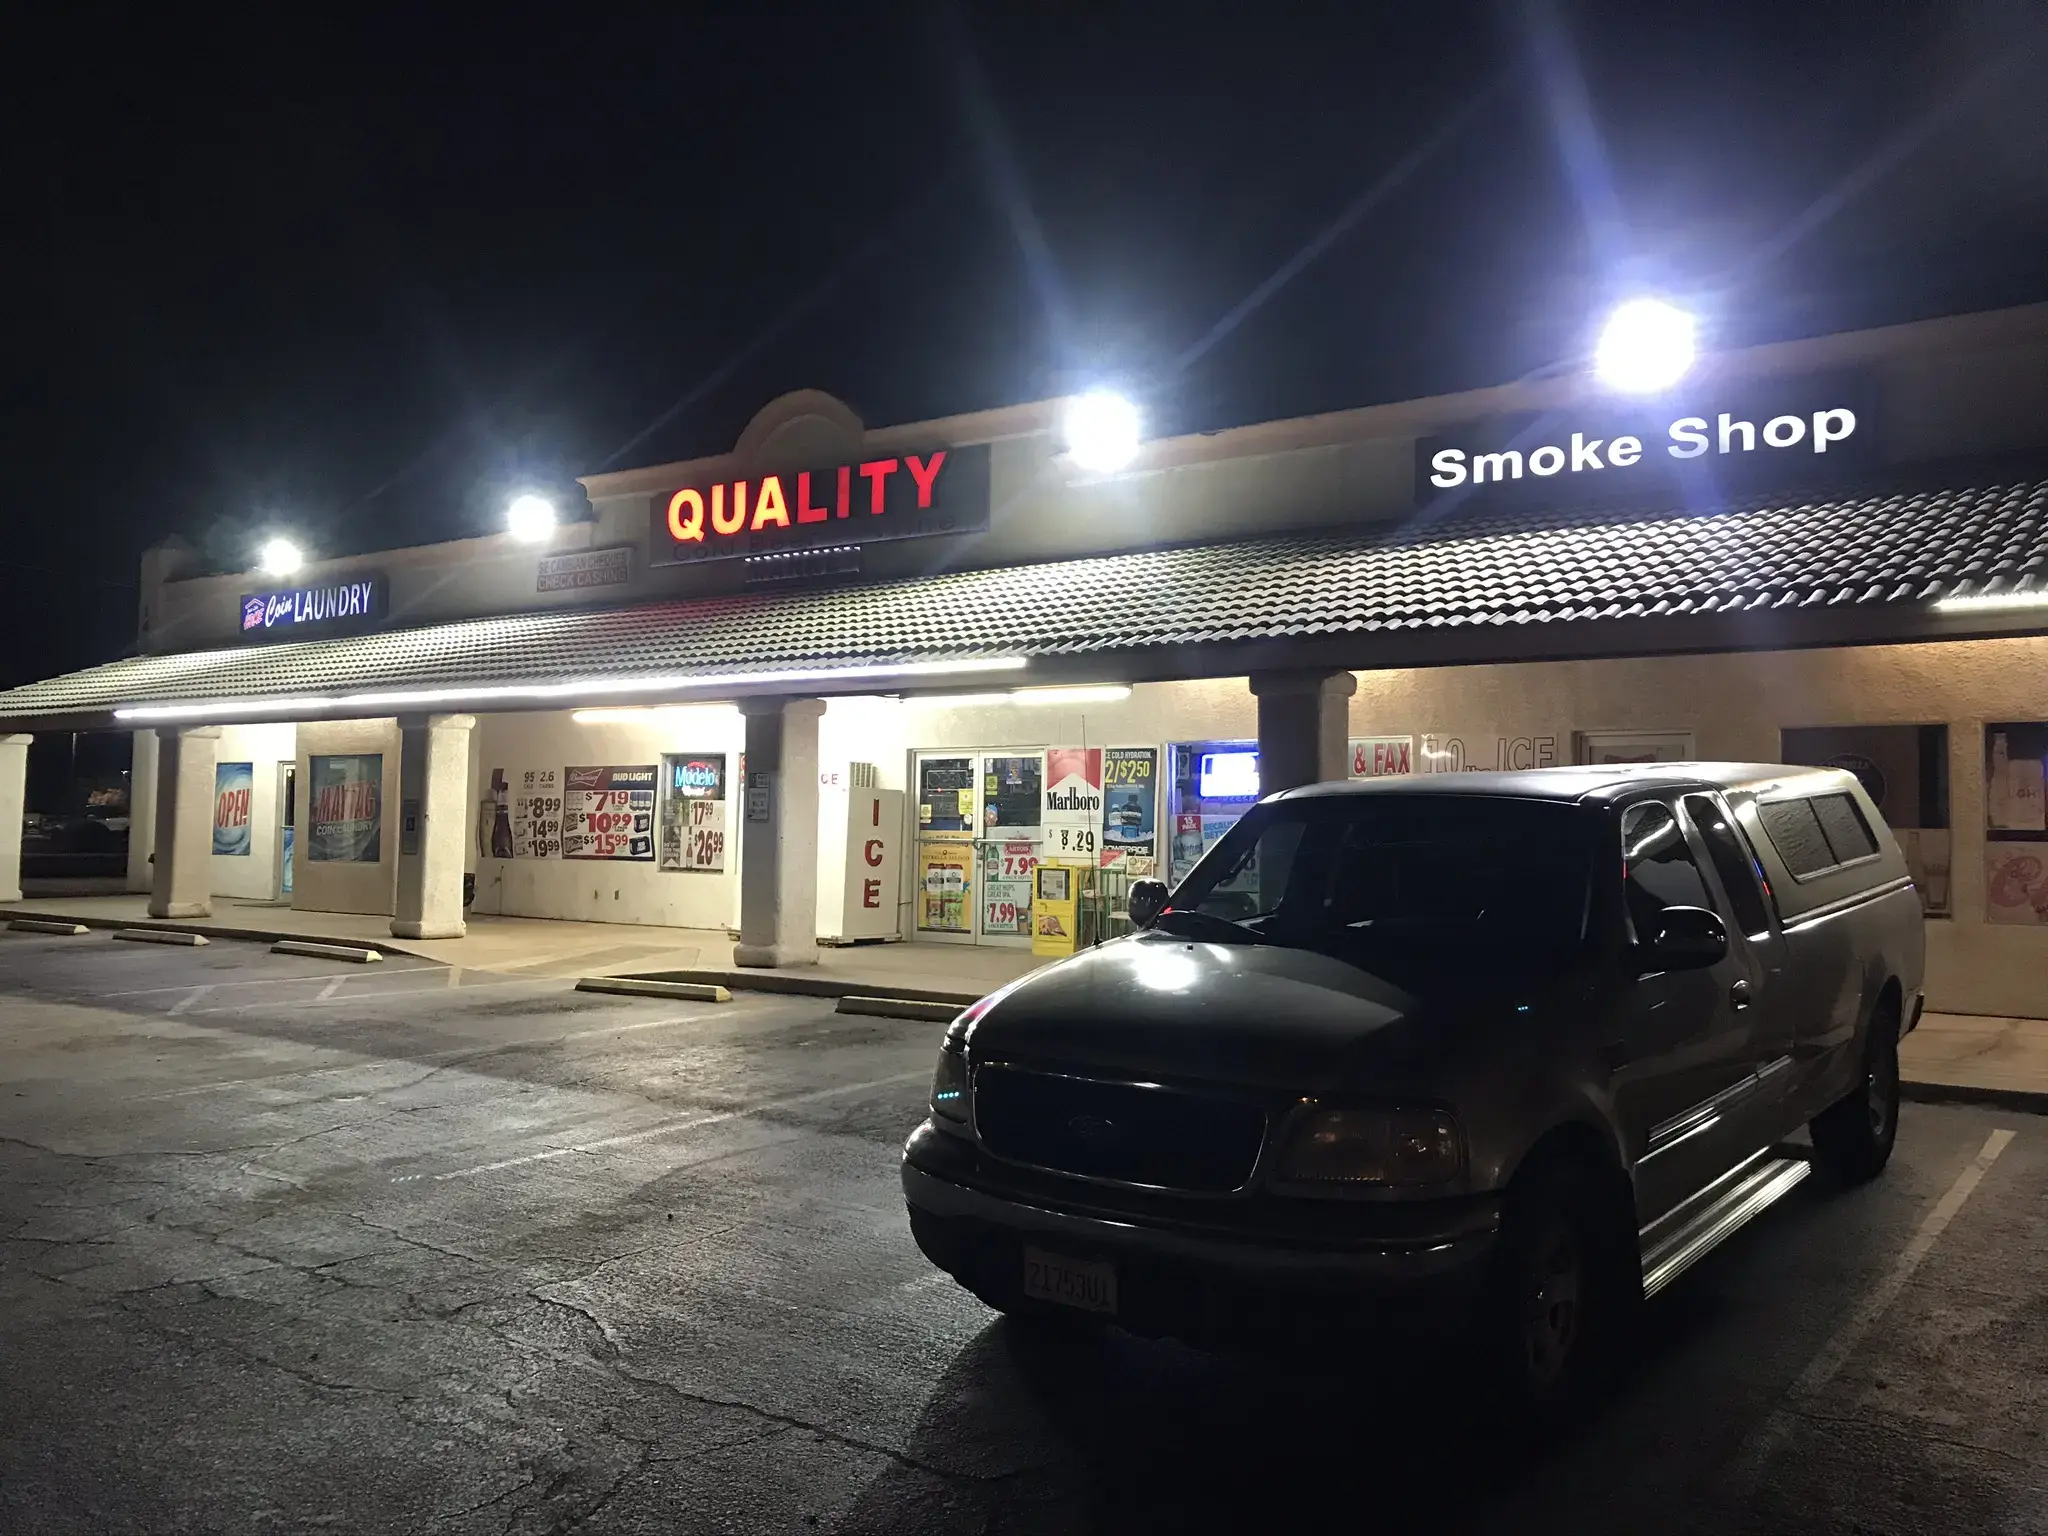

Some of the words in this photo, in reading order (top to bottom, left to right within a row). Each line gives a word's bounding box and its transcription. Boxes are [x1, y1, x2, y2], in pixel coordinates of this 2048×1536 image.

[1430, 432, 1642, 488] Smoke
[1667, 407, 1857, 459] Shop
[667, 450, 948, 543] QUALITY
[265, 595, 292, 627] Coin
[294, 582, 372, 622] LAUNDRY
[1111, 751, 1124, 759] COLD
[1353, 744, 1367, 775] &
[1373, 742, 1411, 775] FAX
[1497, 736, 1555, 773] ICE
[524, 772, 535, 783] 95
[540, 771, 555, 782] 2.6
[612, 772, 628, 781] BUD
[629, 772, 653, 782] LIGHT
[675, 766, 715, 787] Modelo
[217, 788, 249, 828] OPEN
[1046, 787, 1100, 811] Marlboro
[1184, 816, 1194, 825] 15
[1203, 820, 1237, 831] BECAUS
[986, 902, 1015, 923] $7.99
